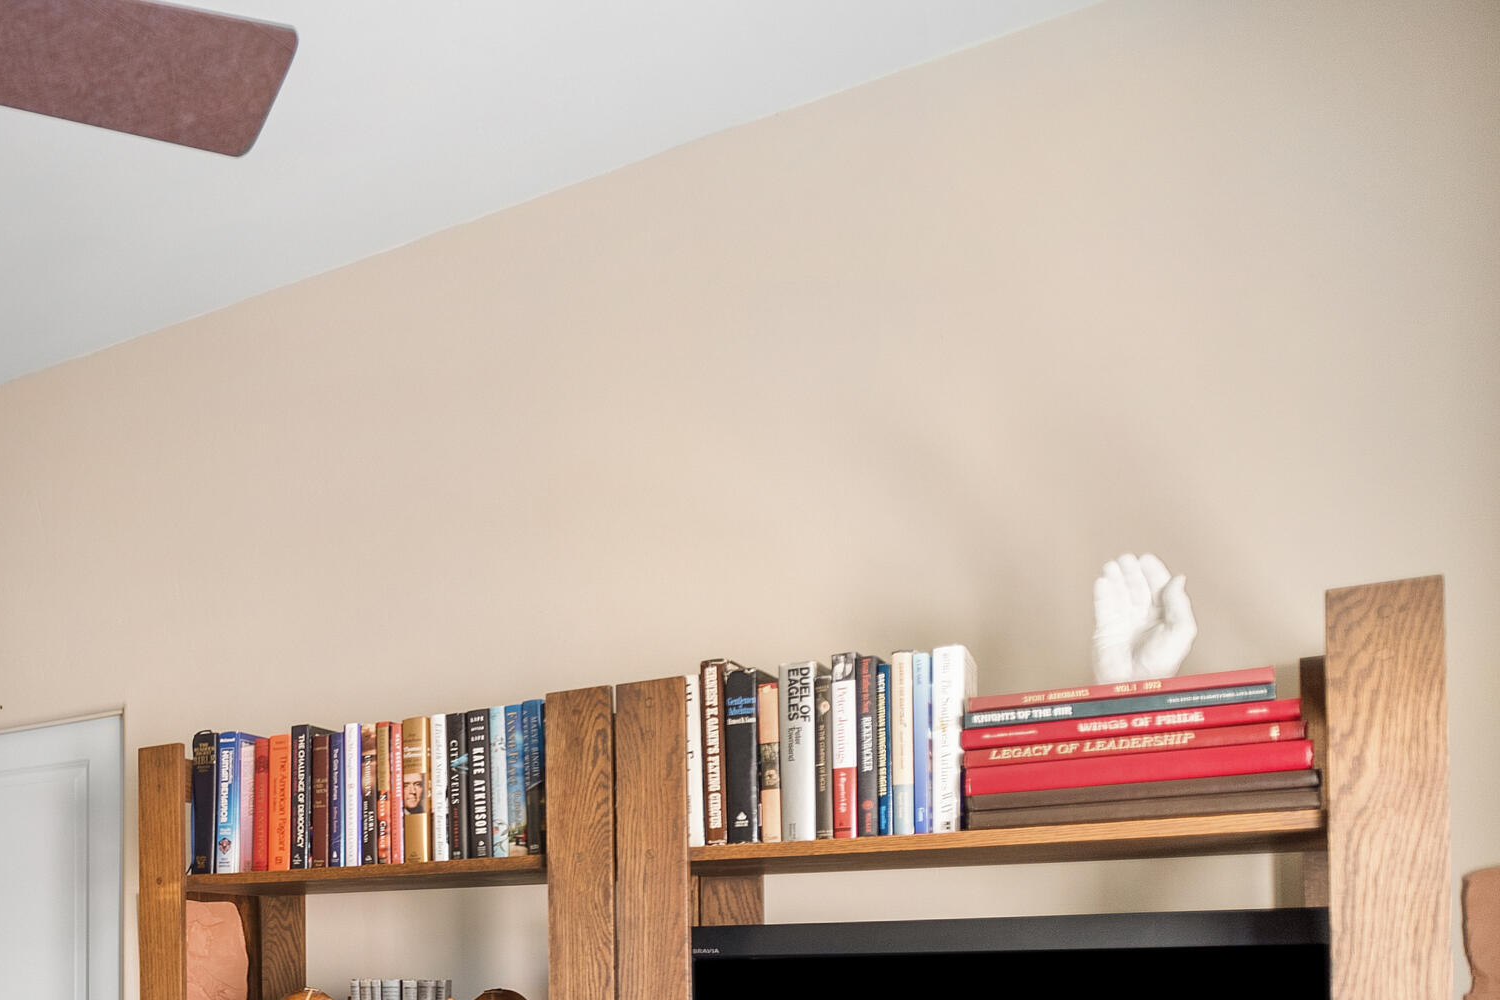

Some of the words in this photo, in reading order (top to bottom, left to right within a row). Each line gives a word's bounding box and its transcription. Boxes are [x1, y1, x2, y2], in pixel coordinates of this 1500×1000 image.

[705, 667, 718, 706] ERNEST
[788, 668, 799, 721] EAGLES
[800, 667, 810, 702] DUEL
[837, 687, 849, 717] Peter
[877, 693, 886, 727] JONATHAN
[972, 712, 1016, 724] KNIGHTS
[1077, 719, 1129, 733] WINGS
[1155, 711, 1205, 726] PRIDE
[707, 719, 720, 754] GANN'S
[788, 727, 796, 762] Townsend
[836, 718, 848, 765] Jennings
[860, 717, 873, 773] RICKENBACKER
[877, 728, 887, 767] LIVINGSTON
[989, 745, 1053, 761] LEGACY
[1083, 732, 1196, 753] LEADERSHIP
[297, 749, 306, 793] CHALLENGE
[473, 746, 485, 775] KATE
[709, 756, 720, 791] FLYING
[279, 775, 288, 816] American
[379, 795, 388, 818] NEVER
[451, 774, 461, 805] VEILS
[474, 779, 487, 836] ATKINSON
[710, 793, 722, 828] CIRCUS
[276, 818, 288, 852] Pageant
[297, 804, 306, 848] DEMOCRACY
[379, 820, 388, 849] CHANGE
